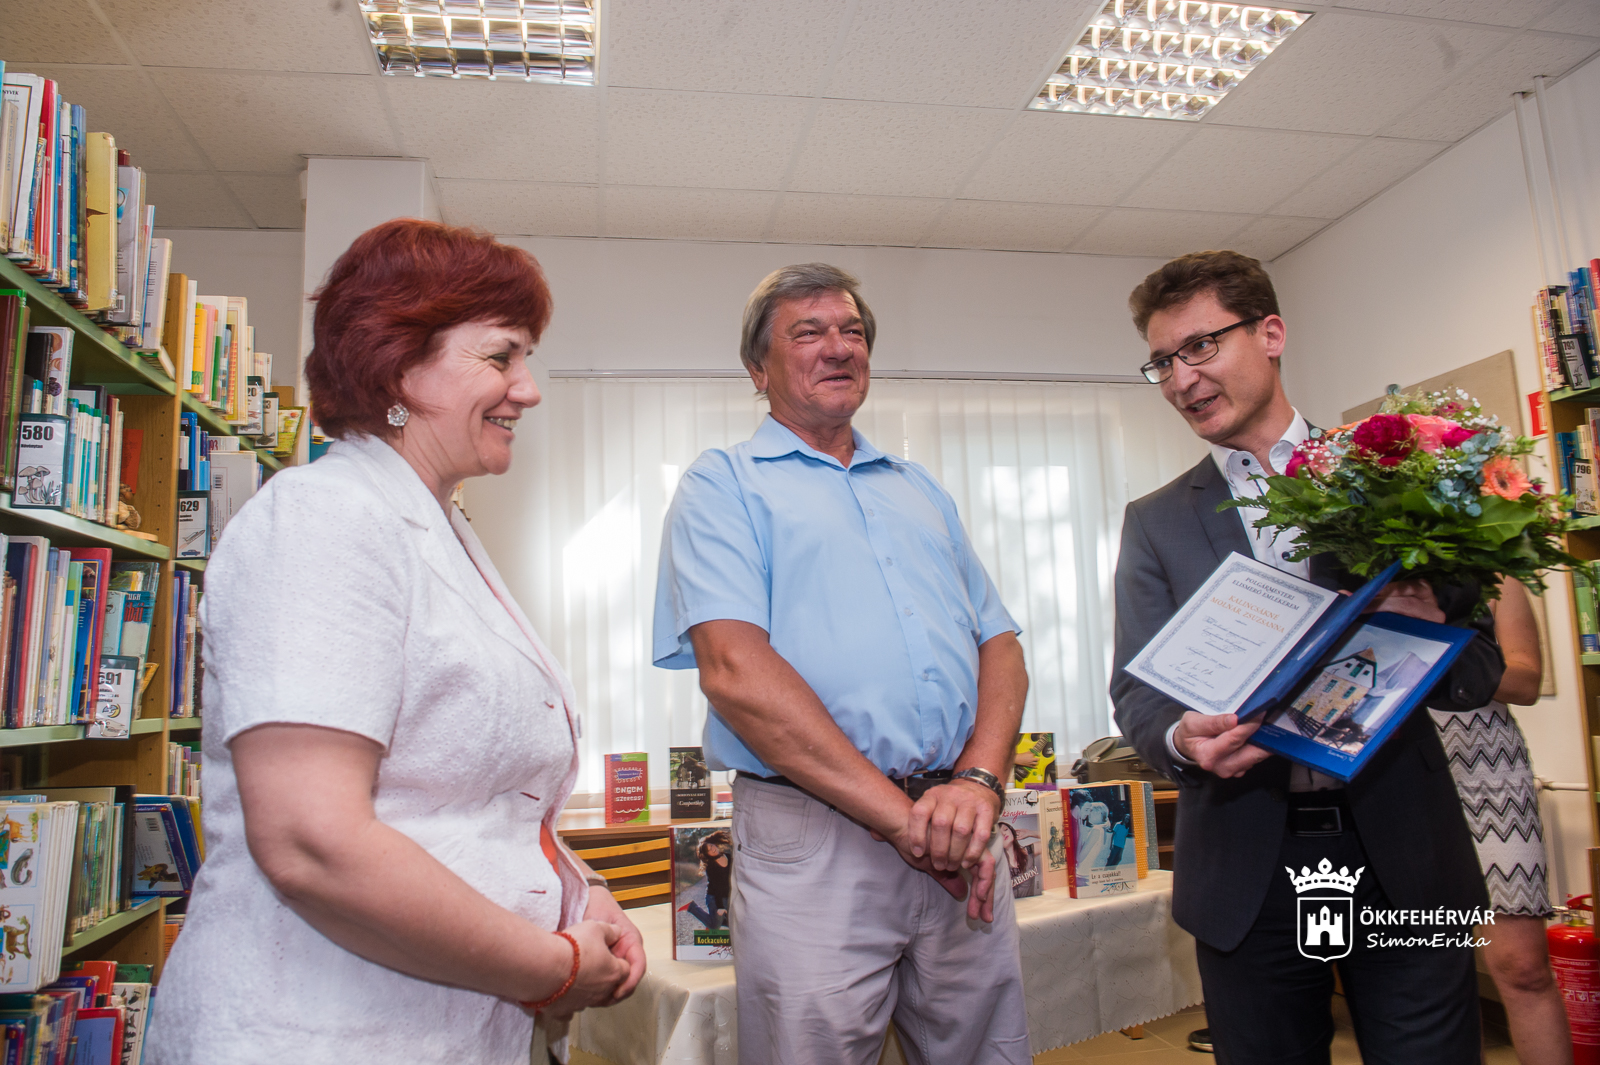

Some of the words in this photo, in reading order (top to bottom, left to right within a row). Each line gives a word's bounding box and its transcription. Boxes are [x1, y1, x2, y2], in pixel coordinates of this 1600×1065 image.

[1563, 341, 1575, 351] 793
[22, 425, 54, 441] 580
[1576, 464, 1591, 475] 796
[180, 500, 199, 512] 629
[1232, 579, 1262, 595] ELISMERŐ
[1245, 577, 1295, 600] POLGÁRMESTERI
[1210, 596, 1242, 615] MOLNÁR
[1243, 611, 1285, 633] ZSUZSANNA
[1011, 866, 1039, 888] ZABADON!
[697, 936, 730, 945] Kockacukor
